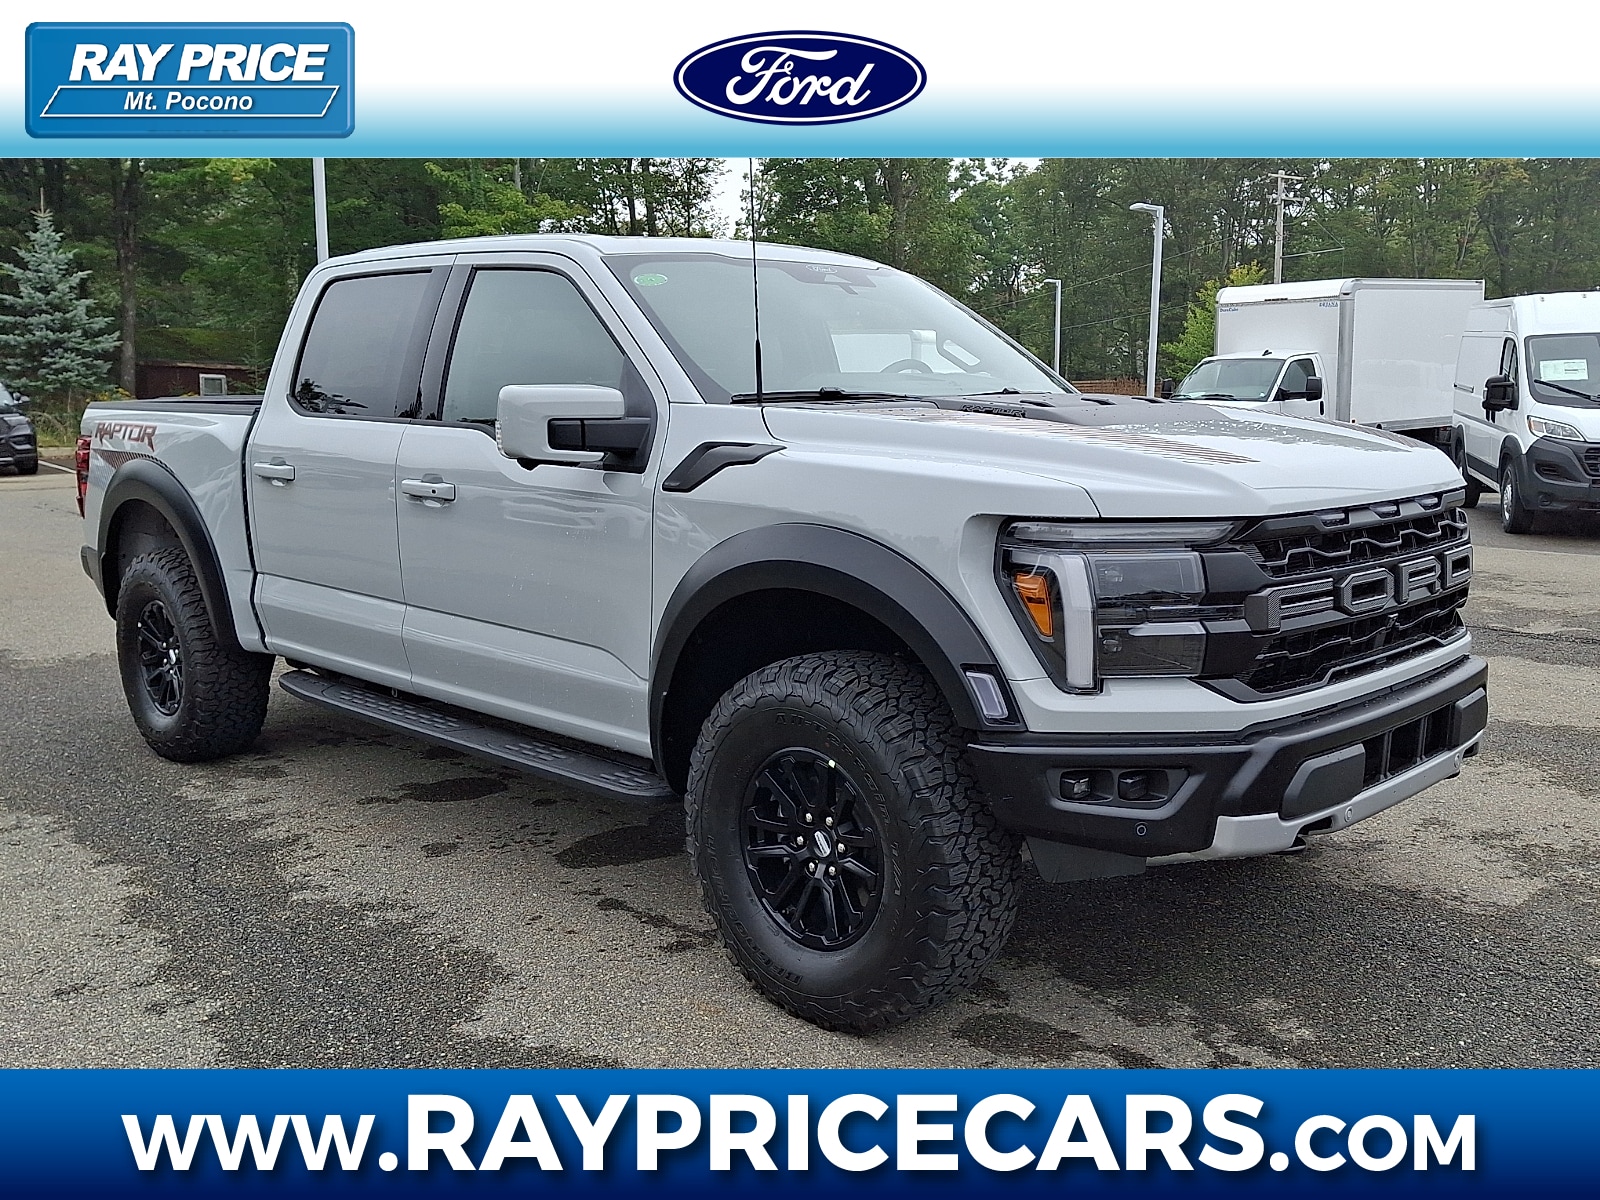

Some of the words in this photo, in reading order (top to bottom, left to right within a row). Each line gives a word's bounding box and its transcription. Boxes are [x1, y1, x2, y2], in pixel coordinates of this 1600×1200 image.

[960, 403, 1027, 418] RAPTOR
[94, 422, 158, 452] RAPTOR
[1250, 545, 1474, 636] FORD
